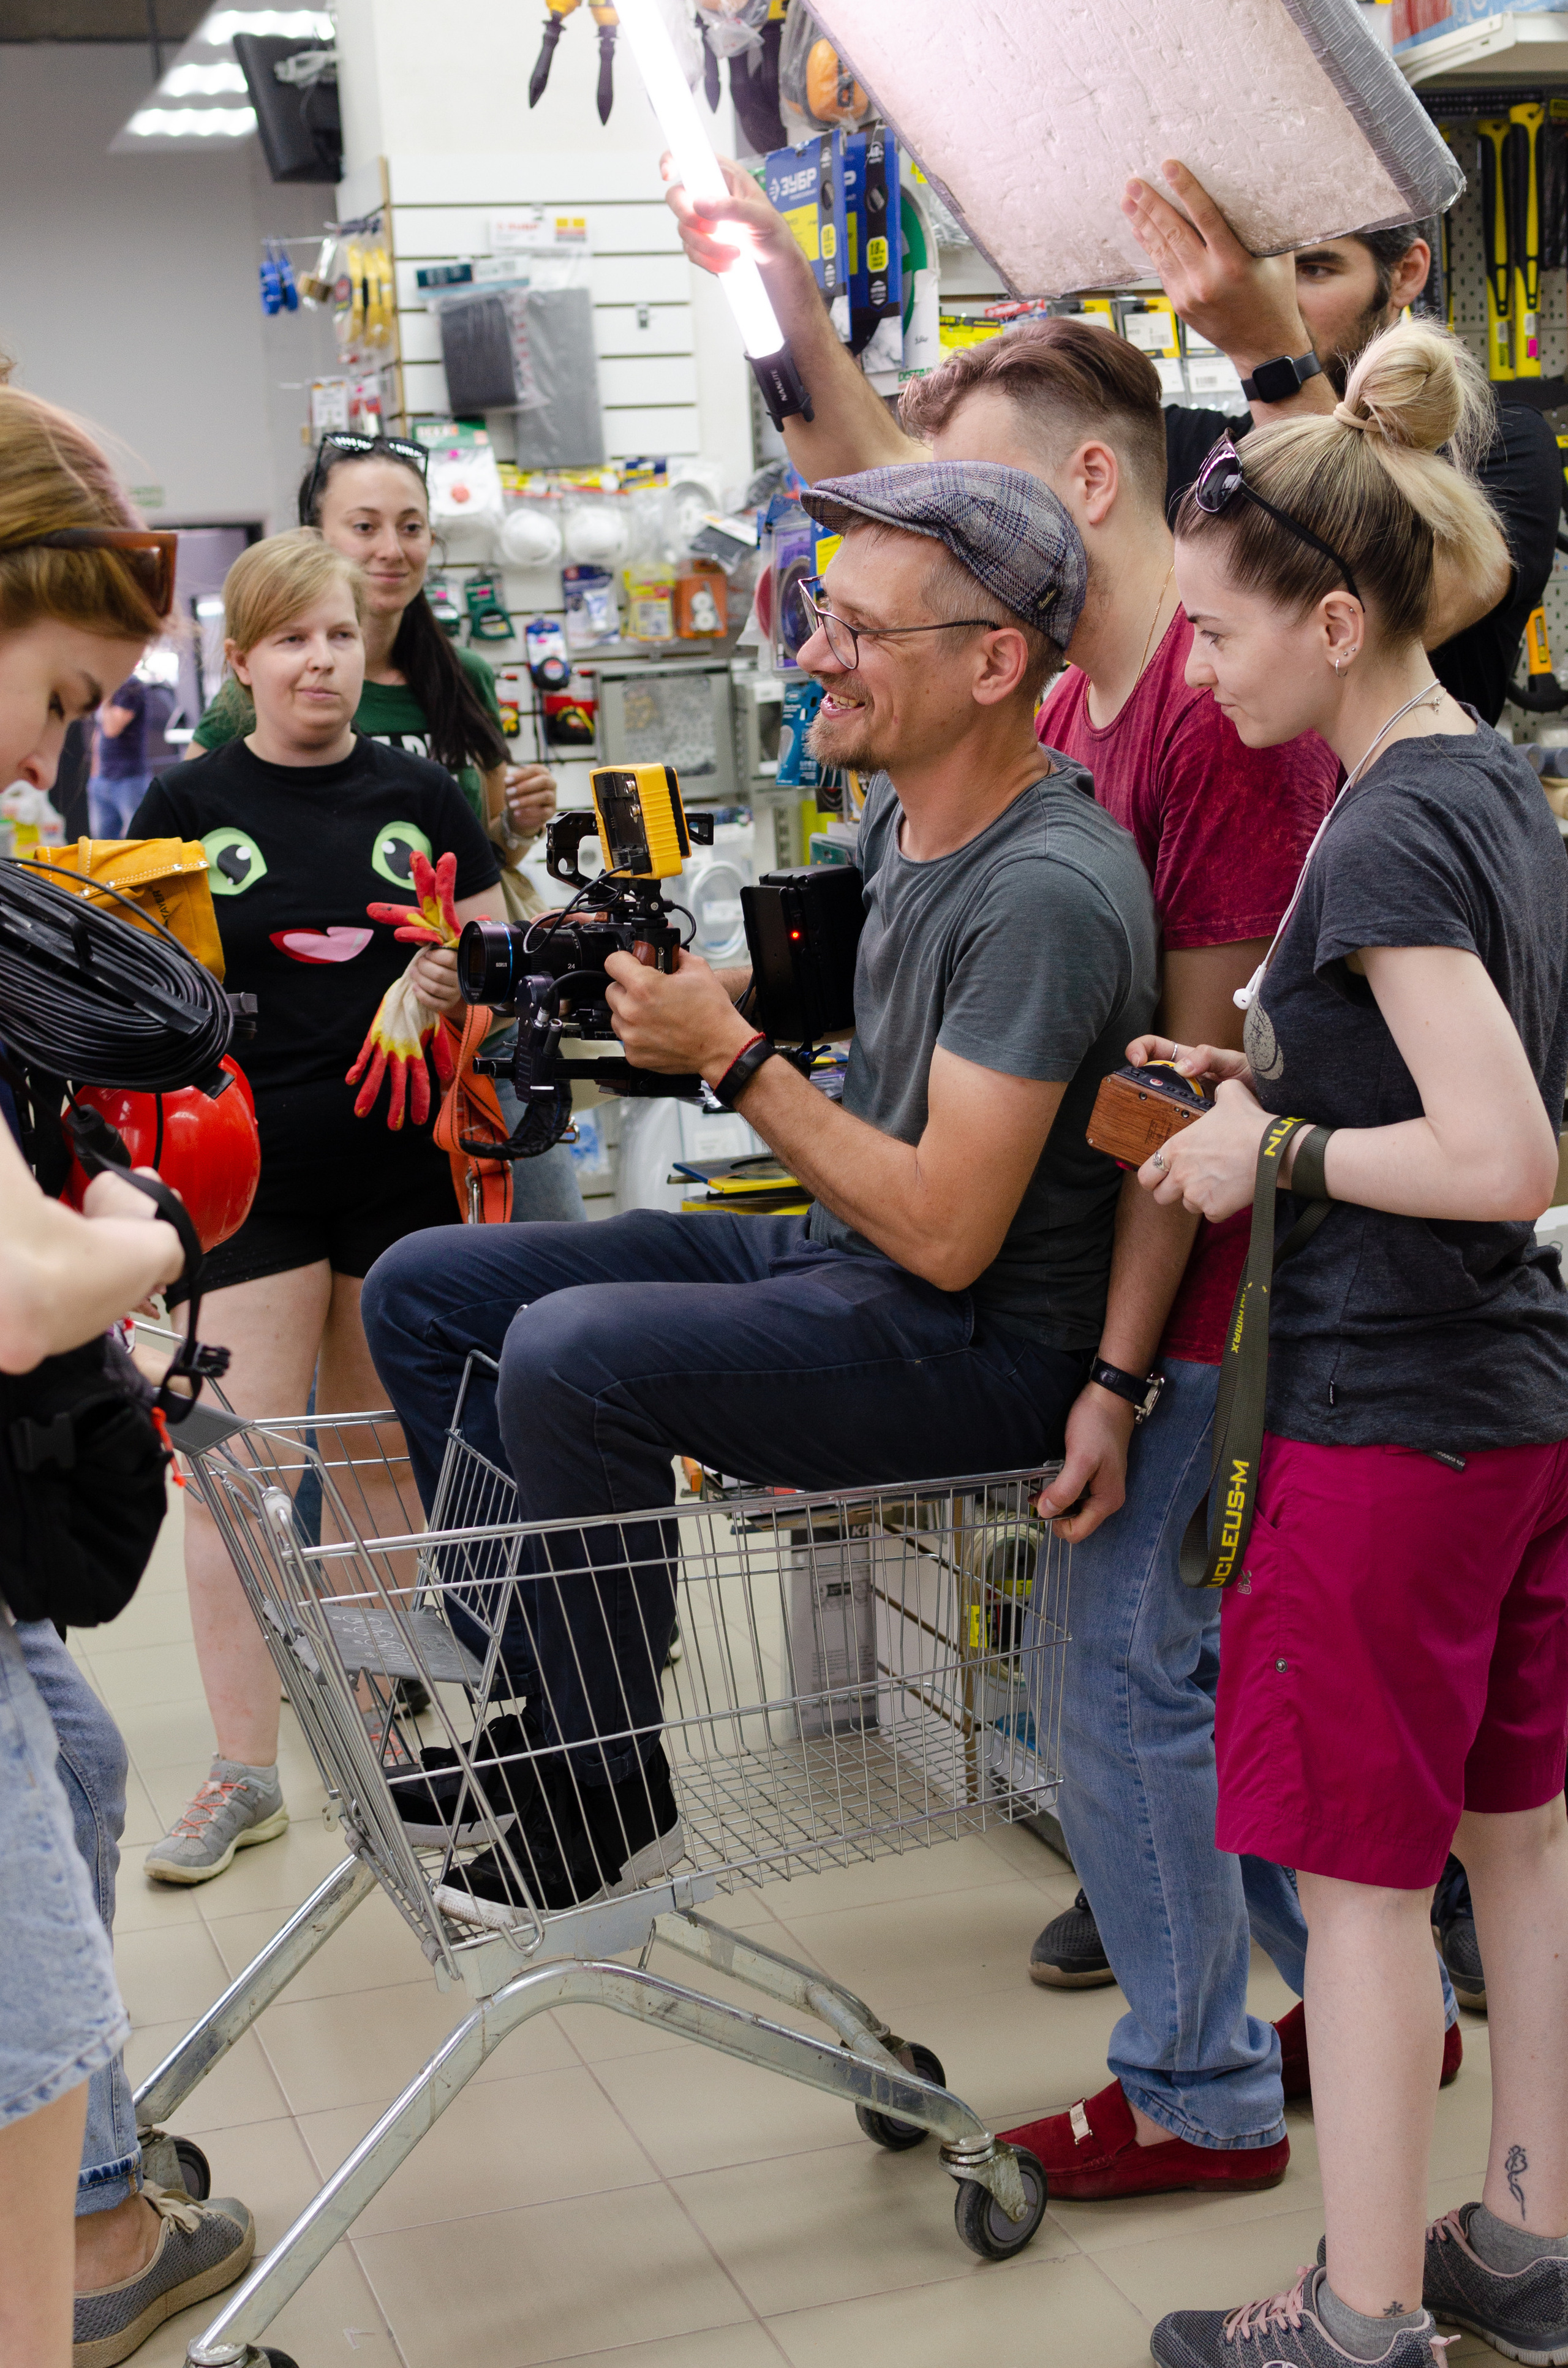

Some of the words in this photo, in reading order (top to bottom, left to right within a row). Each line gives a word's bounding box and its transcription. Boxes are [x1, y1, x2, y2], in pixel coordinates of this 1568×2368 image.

[780, 167, 817, 196] ЗУБР
[771, 369, 788, 401] NANLITE
[153, 890, 172, 928] TAYER
[1205, 1459, 1250, 1588] UCLEUS-M
